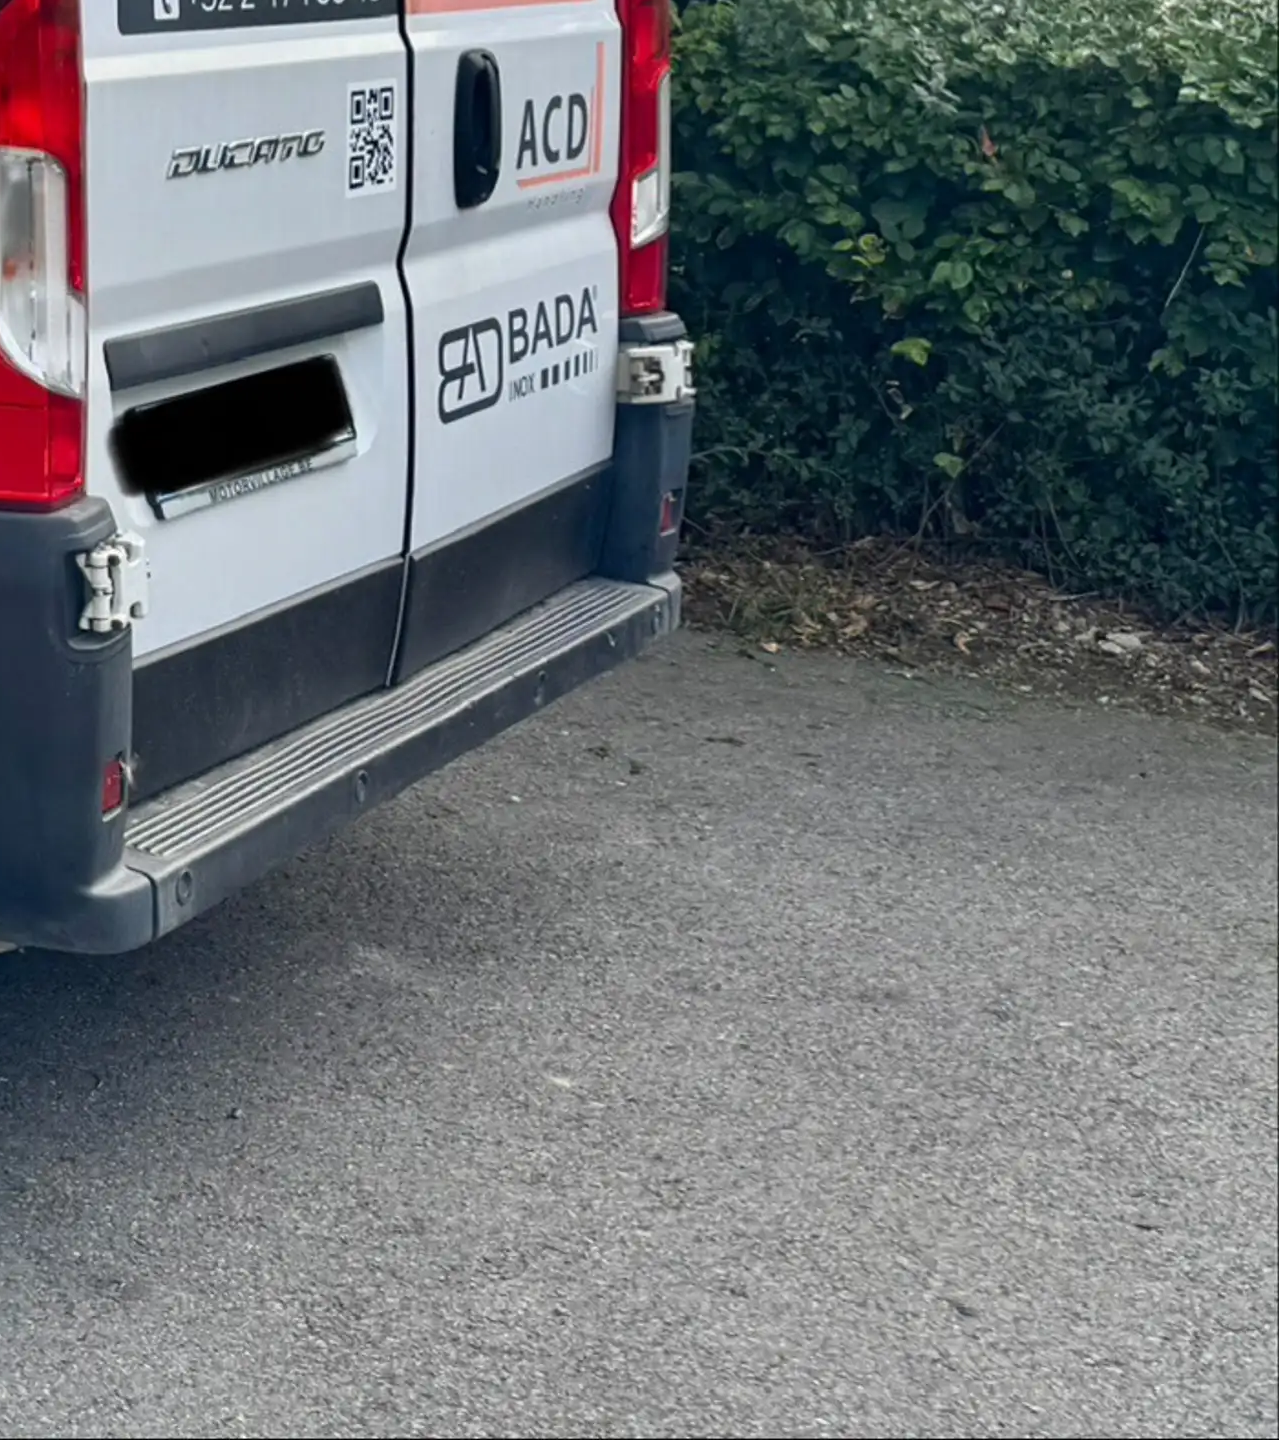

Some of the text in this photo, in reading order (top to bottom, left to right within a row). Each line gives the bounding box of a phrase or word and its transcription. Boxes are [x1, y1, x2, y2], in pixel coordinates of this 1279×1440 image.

[165, 128, 326, 180] DUCATO
[516, 92, 589, 171] ACD
[508, 286, 598, 365] BADA
[508, 372, 536, 403] INOX
